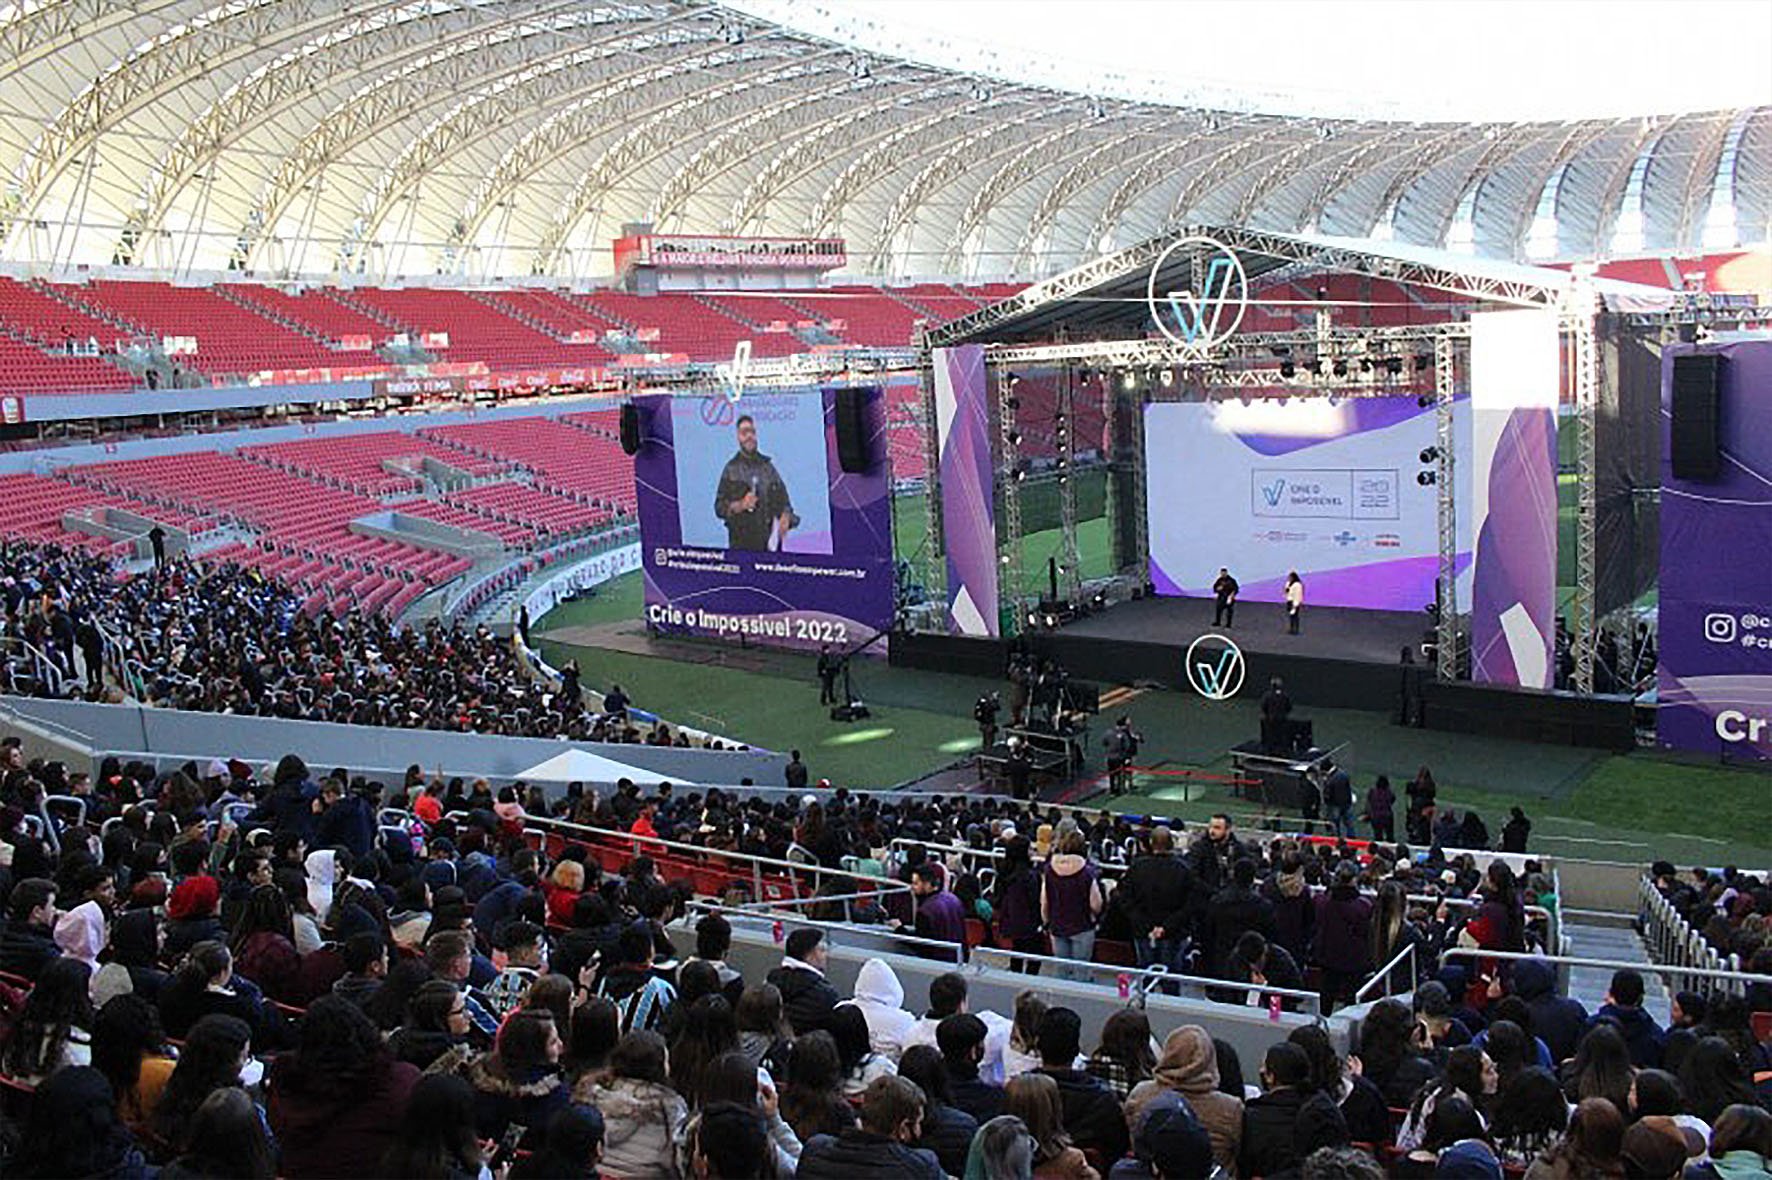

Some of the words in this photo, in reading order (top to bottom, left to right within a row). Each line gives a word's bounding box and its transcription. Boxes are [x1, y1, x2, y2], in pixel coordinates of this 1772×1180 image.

[650, 604, 682, 624] Crie
[685, 612, 696, 627] o
[796, 619, 848, 643] 2022
